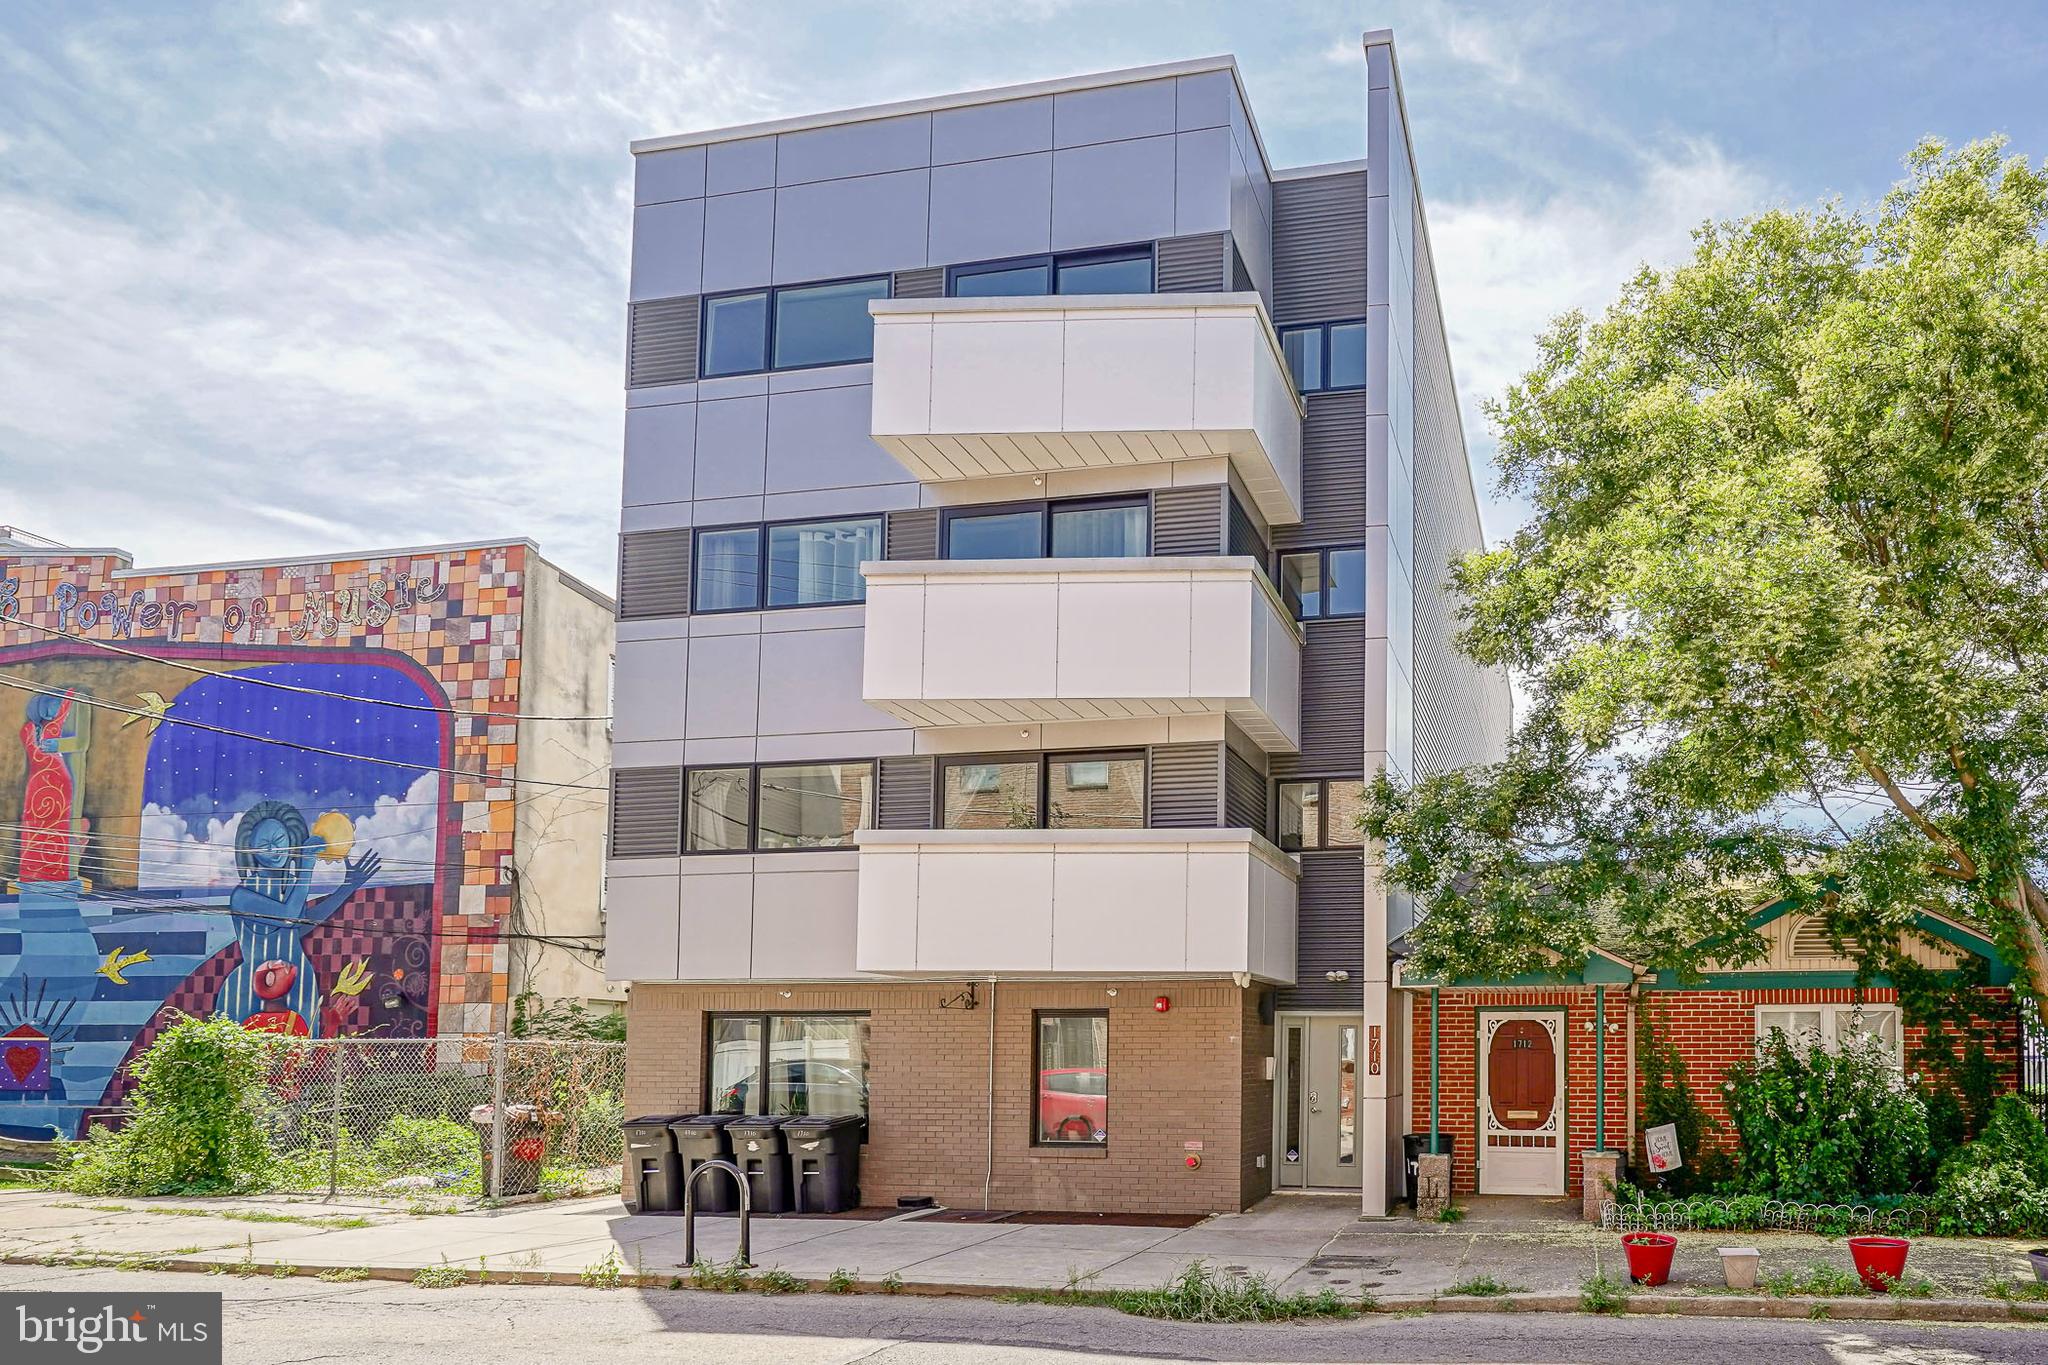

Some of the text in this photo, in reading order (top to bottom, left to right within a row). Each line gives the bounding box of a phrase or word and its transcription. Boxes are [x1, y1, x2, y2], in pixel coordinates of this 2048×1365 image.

[290, 572, 446, 641] Music
[1370, 1026, 1379, 1074] 1710
[1513, 1039, 1533, 1048] 1712
